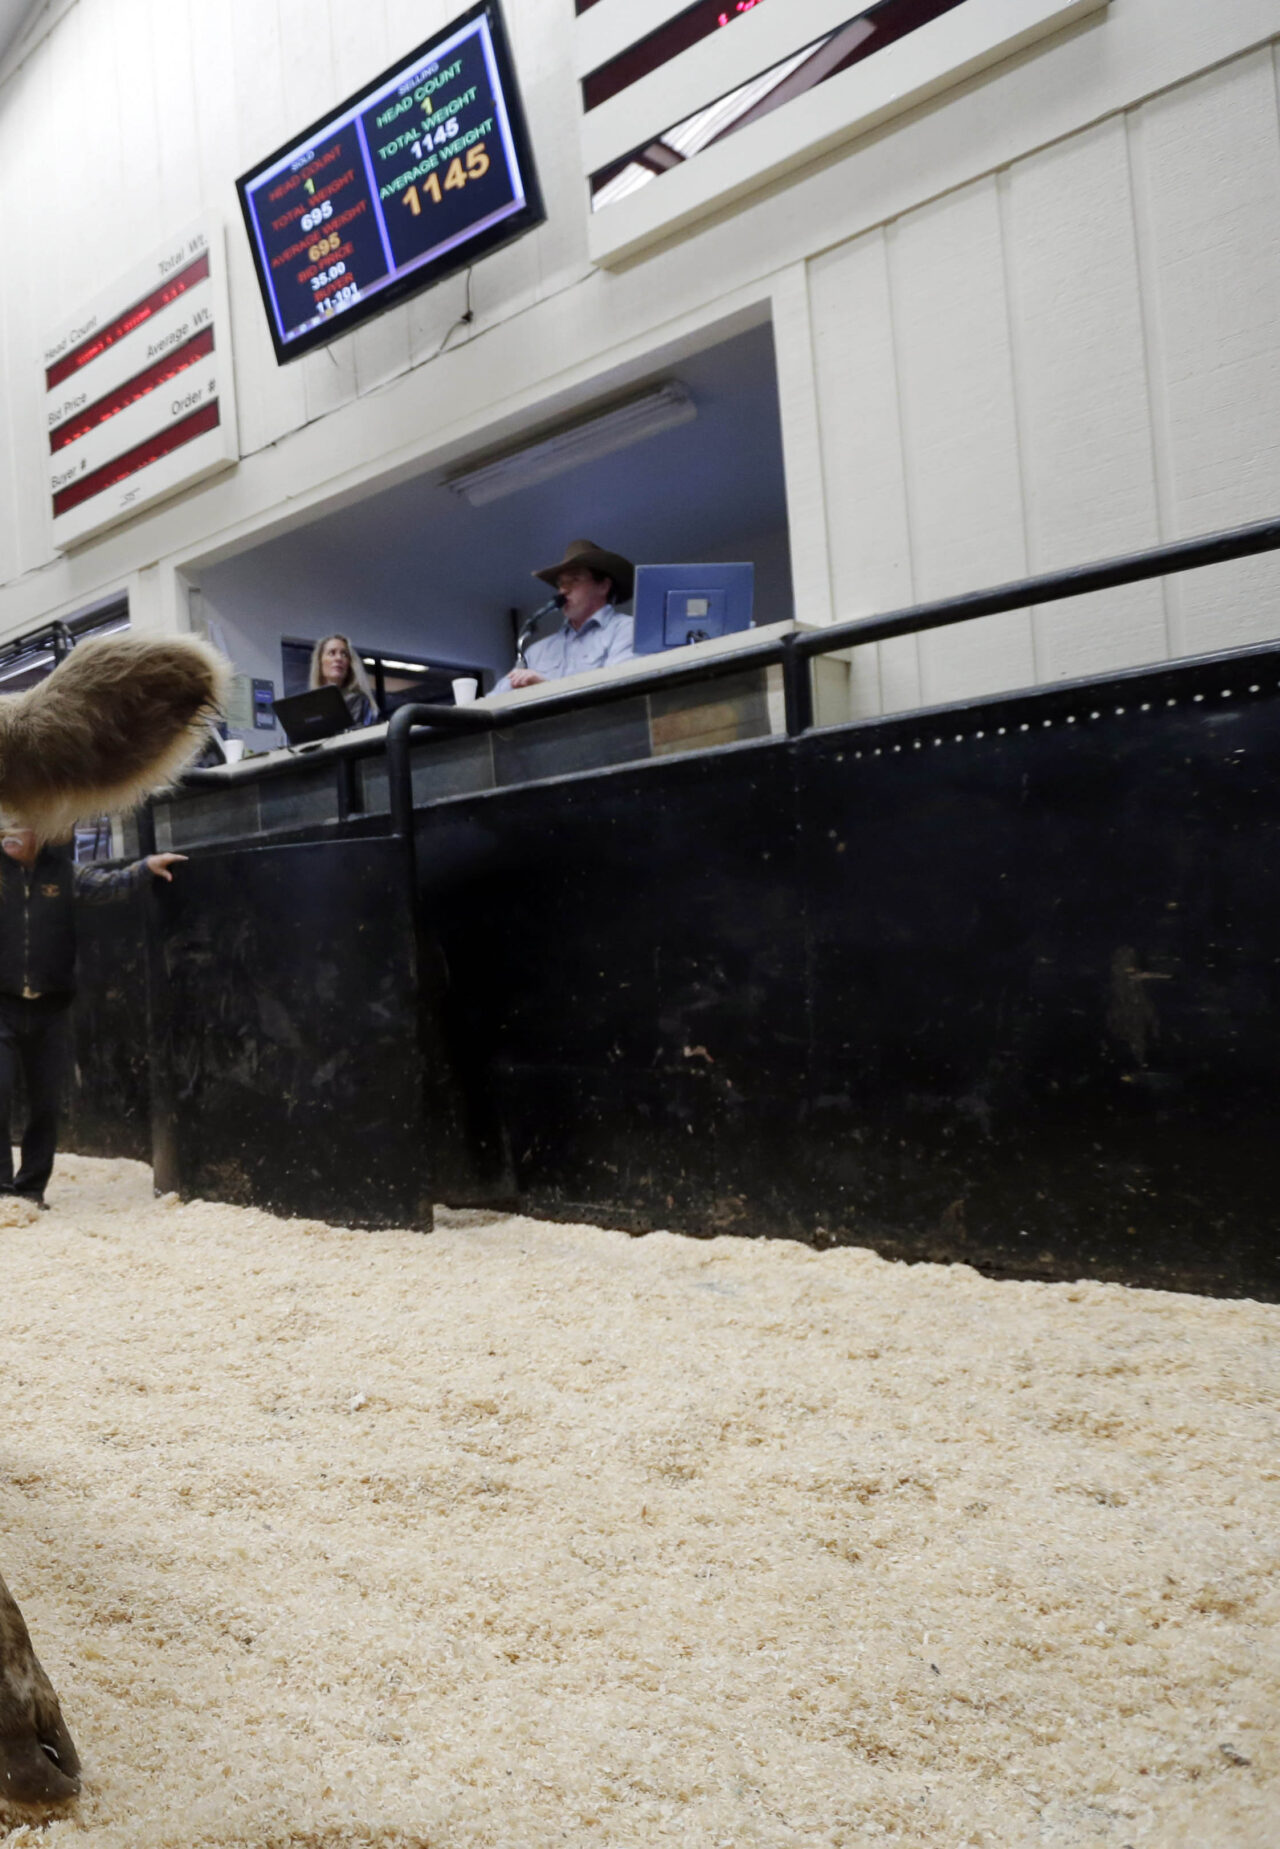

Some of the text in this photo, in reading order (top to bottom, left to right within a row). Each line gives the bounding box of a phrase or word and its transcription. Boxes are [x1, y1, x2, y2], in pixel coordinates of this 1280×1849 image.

[376, 59, 462, 128] HEAD COUNT
[398, 62, 440, 96] SELLING
[421, 96, 433, 115] 1
[378, 86, 477, 159] TOTAL WEIGHT
[410, 116, 459, 159] 1145
[269, 144, 341, 203] HEAD COUNT
[291, 149, 315, 172] SOLD
[380, 117, 493, 200] AVERAGE WEIGHT
[304, 177, 315, 195] 1
[402, 142, 490, 216] 1145
[272, 169, 354, 231] TOTAL WEIGHT
[301, 200, 333, 232] 695
[271, 199, 366, 268] AVERAGE WEIGHT
[308, 231, 340, 261] 695
[158, 247, 185, 275] Total
[318, 241, 354, 270] PRICE
[310, 261, 346, 291] 35.00
[313, 271, 355, 302] BUYER
[147, 323, 189, 358] Average
[171, 389, 202, 415] Order
